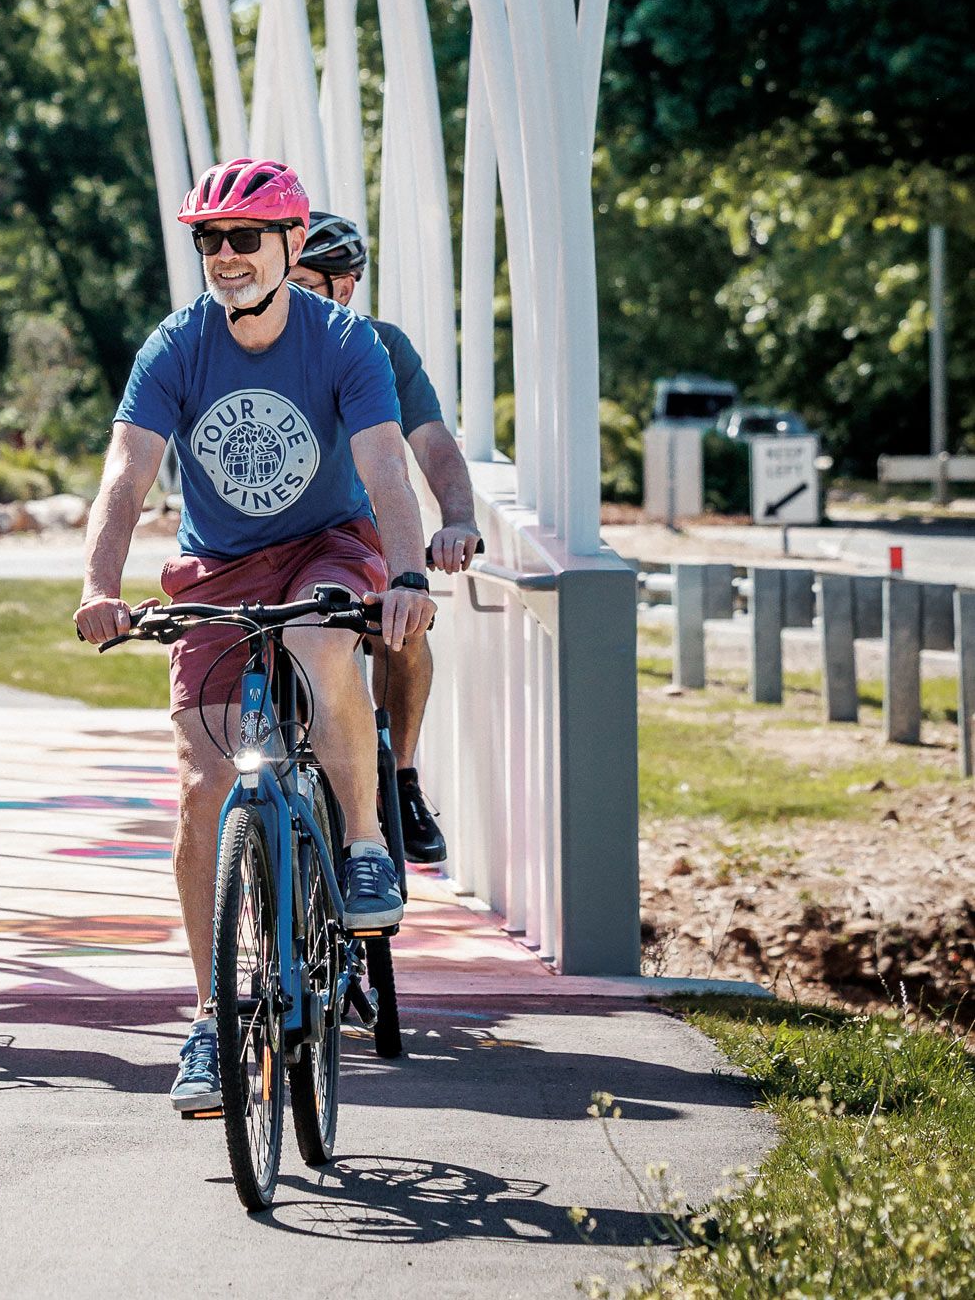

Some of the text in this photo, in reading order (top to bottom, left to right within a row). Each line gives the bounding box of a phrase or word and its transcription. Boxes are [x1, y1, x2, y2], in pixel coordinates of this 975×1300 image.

[197, 398, 308, 510] TOUR DE VINES
